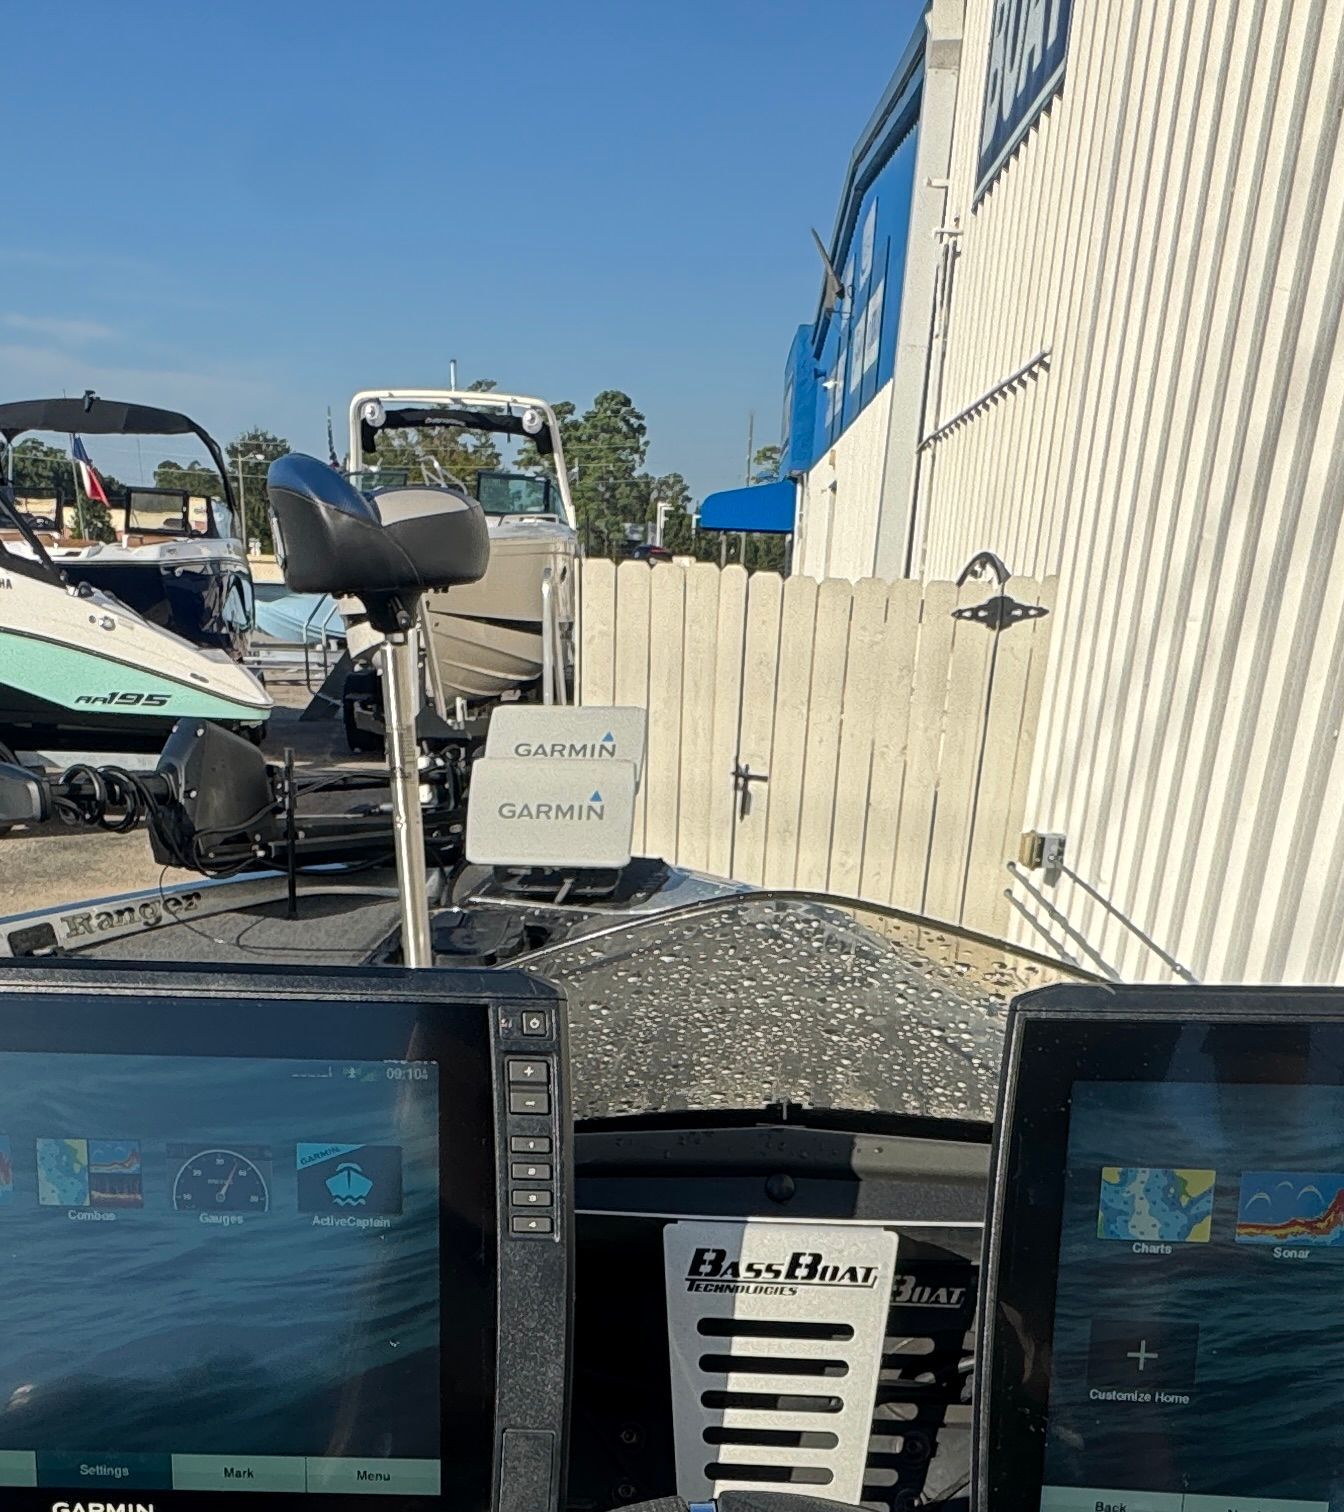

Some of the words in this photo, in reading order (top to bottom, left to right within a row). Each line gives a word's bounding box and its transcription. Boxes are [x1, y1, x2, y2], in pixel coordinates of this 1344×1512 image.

[74, 691, 173, 707] AR195
[514, 743, 616, 758] GARMIN
[498, 803, 605, 820] GARMIN
[60, 891, 202, 939] Ranger
[67, 1208, 116, 1222] Combos
[199, 1212, 244, 1227] Gauges
[312, 1214, 391, 1230] ActiveCaptain
[1131, 1242, 1173, 1256] Charts
[1272, 1246, 1311, 1260] Sonar
[1089, 1389, 1152, 1403] Customize
[1155, 1391, 1190, 1406] Home
[79, 1463, 130, 1479] Settings
[223, 1466, 254, 1479] Mark
[356, 1469, 391, 1482] Menu
